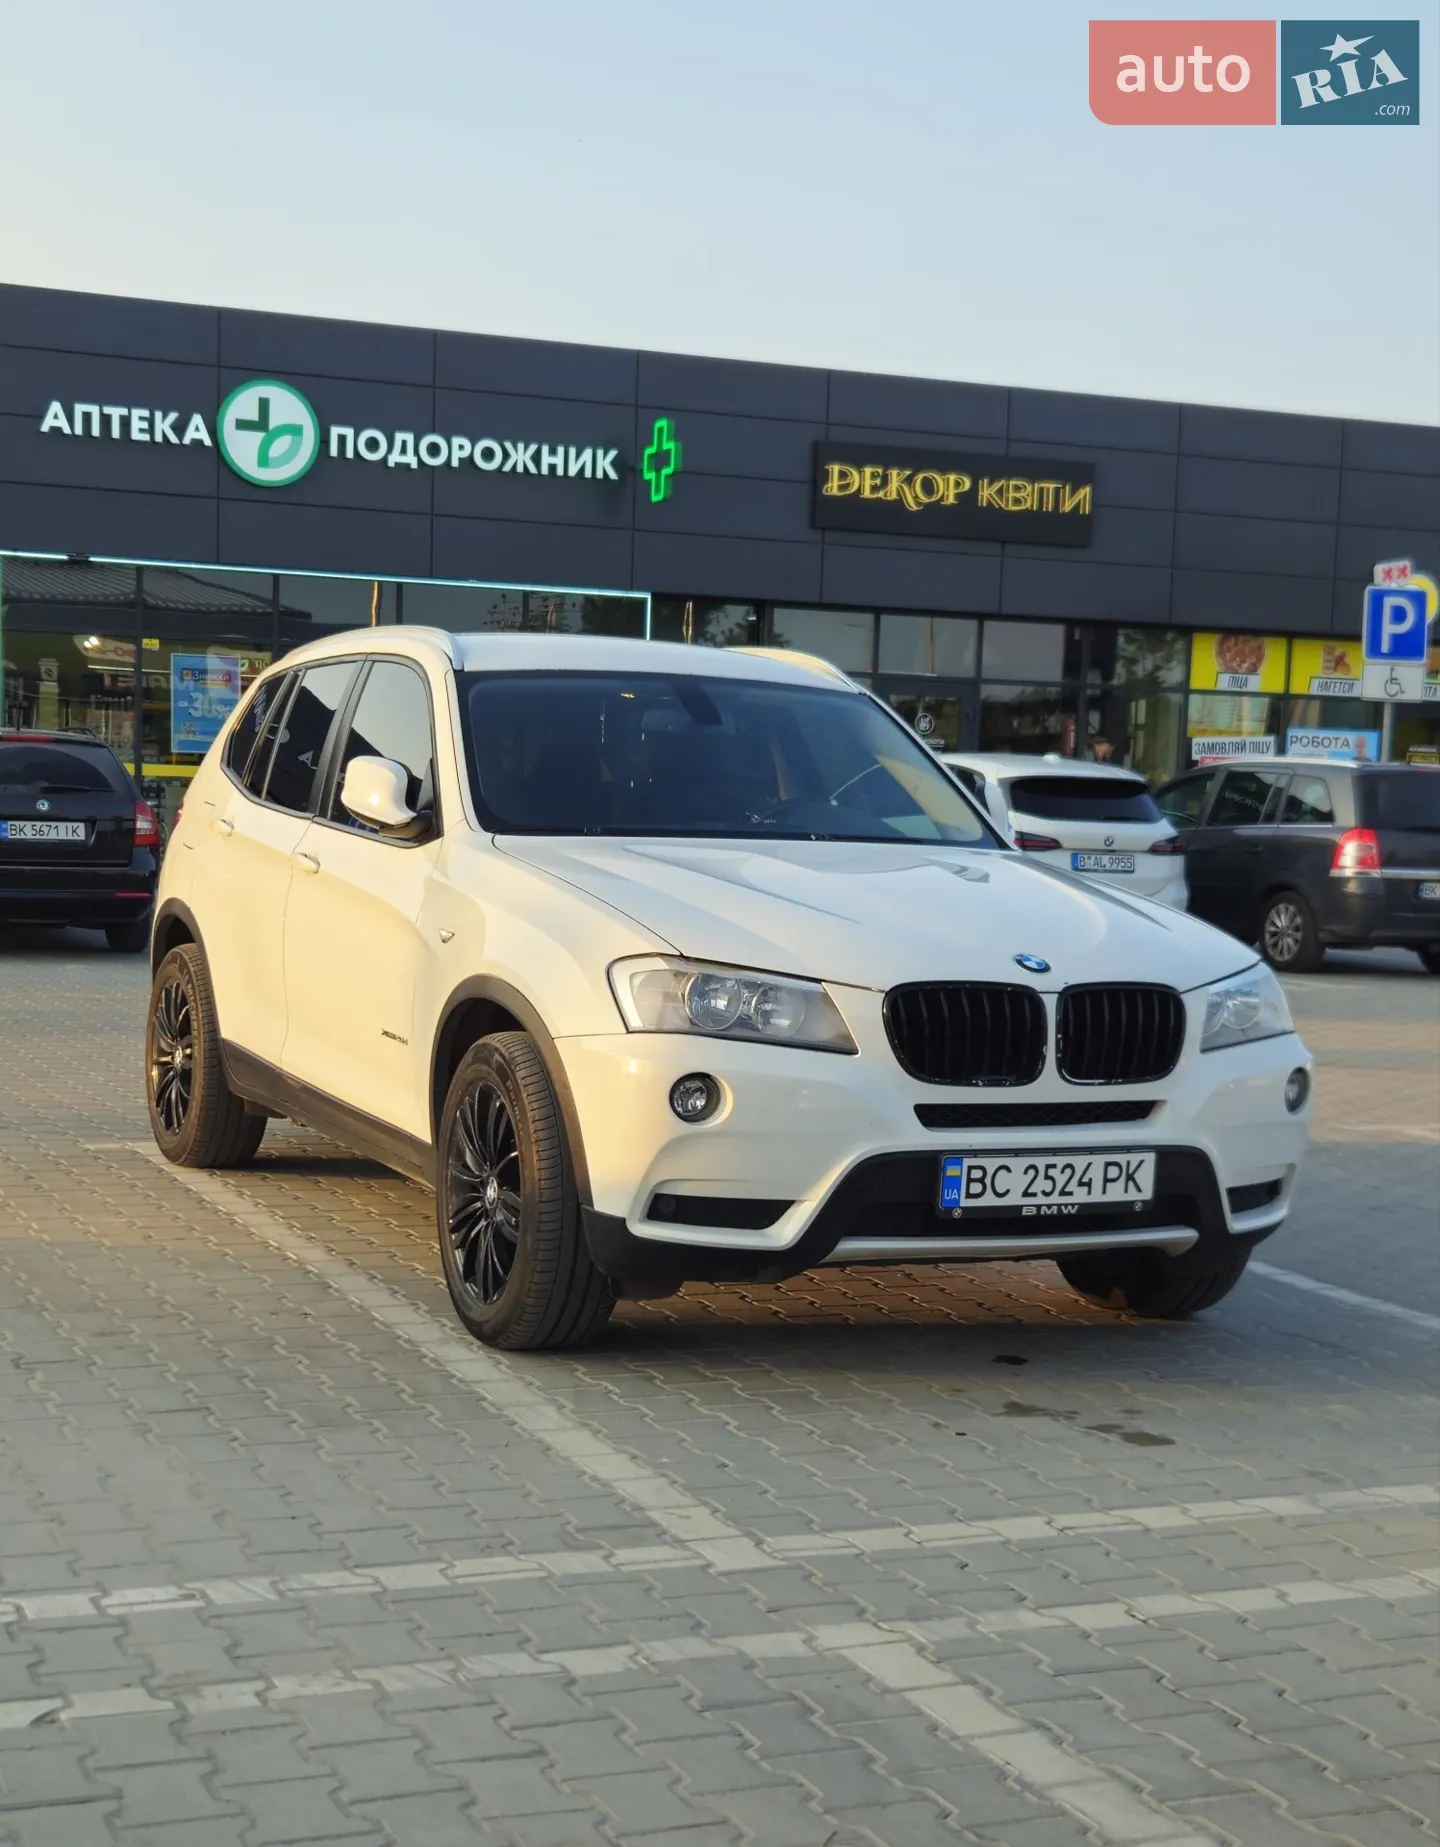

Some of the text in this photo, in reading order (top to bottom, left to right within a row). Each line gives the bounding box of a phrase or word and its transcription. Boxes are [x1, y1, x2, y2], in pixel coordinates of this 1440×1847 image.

[40, 400, 619, 481] АПТЕКА ПОДОРОЖНИК
[822, 462, 1092, 515] ДЕКОР КВІТИ
[1380, 596, 1415, 654] P
[1227, 675, 1249, 689] ПІЦА
[1194, 739, 1272, 756] ЗАМОВЛЯЙ ПІЦУ
[1289, 735, 1351, 749] РОБОТА
[9, 824, 28, 837] BK
[31, 823, 59, 837] 5671
[1108, 856, 1133, 869] 9955
[965, 1159, 1145, 1199] BC 2524 PK
[944, 1189, 959, 1200] UA
[1021, 1205, 1080, 1216] BMW
